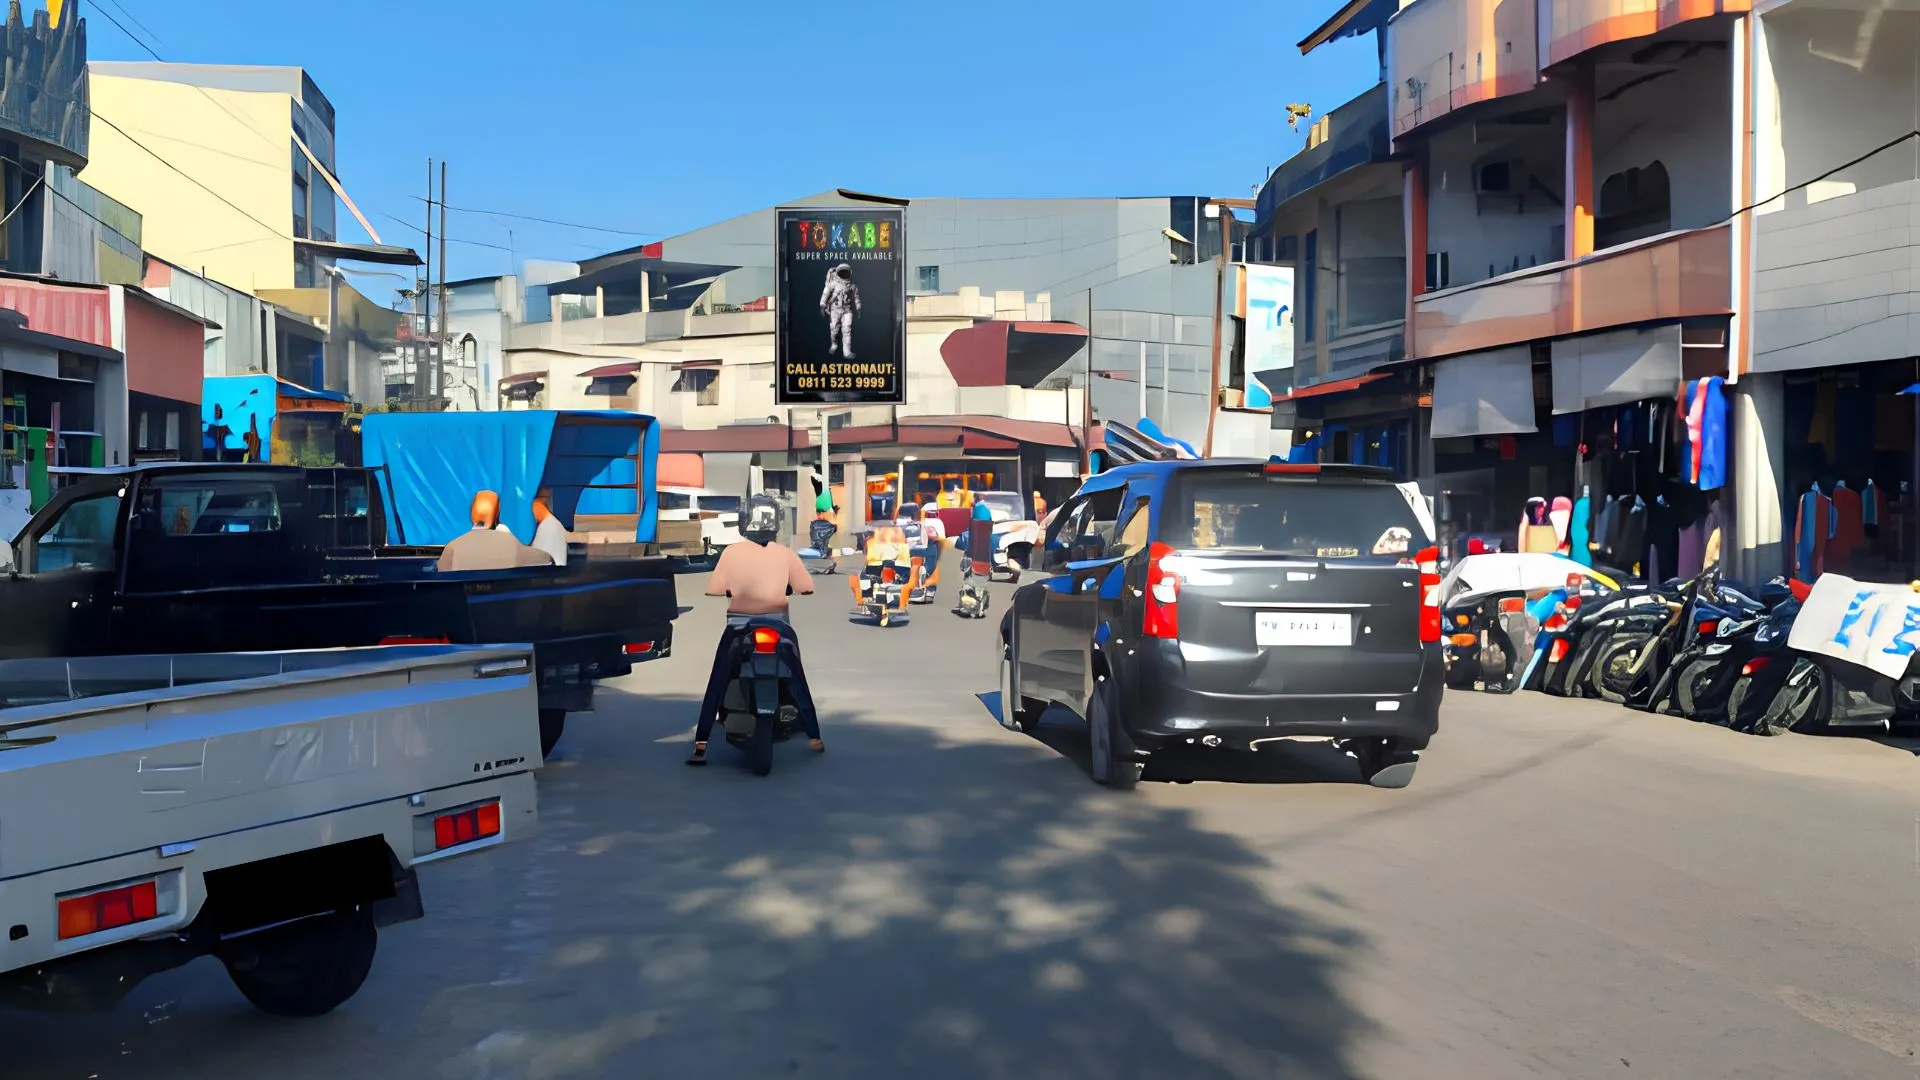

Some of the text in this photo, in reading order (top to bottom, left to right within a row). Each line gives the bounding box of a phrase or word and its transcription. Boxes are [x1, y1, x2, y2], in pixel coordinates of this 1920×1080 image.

[799, 222, 890, 249] TOKABE
[796, 252, 893, 260] SUPER SPACE AVAILABLE
[786, 363, 896, 375] CALL ASTRONAUT:
[798, 376, 885, 388] 0811 523 9999
